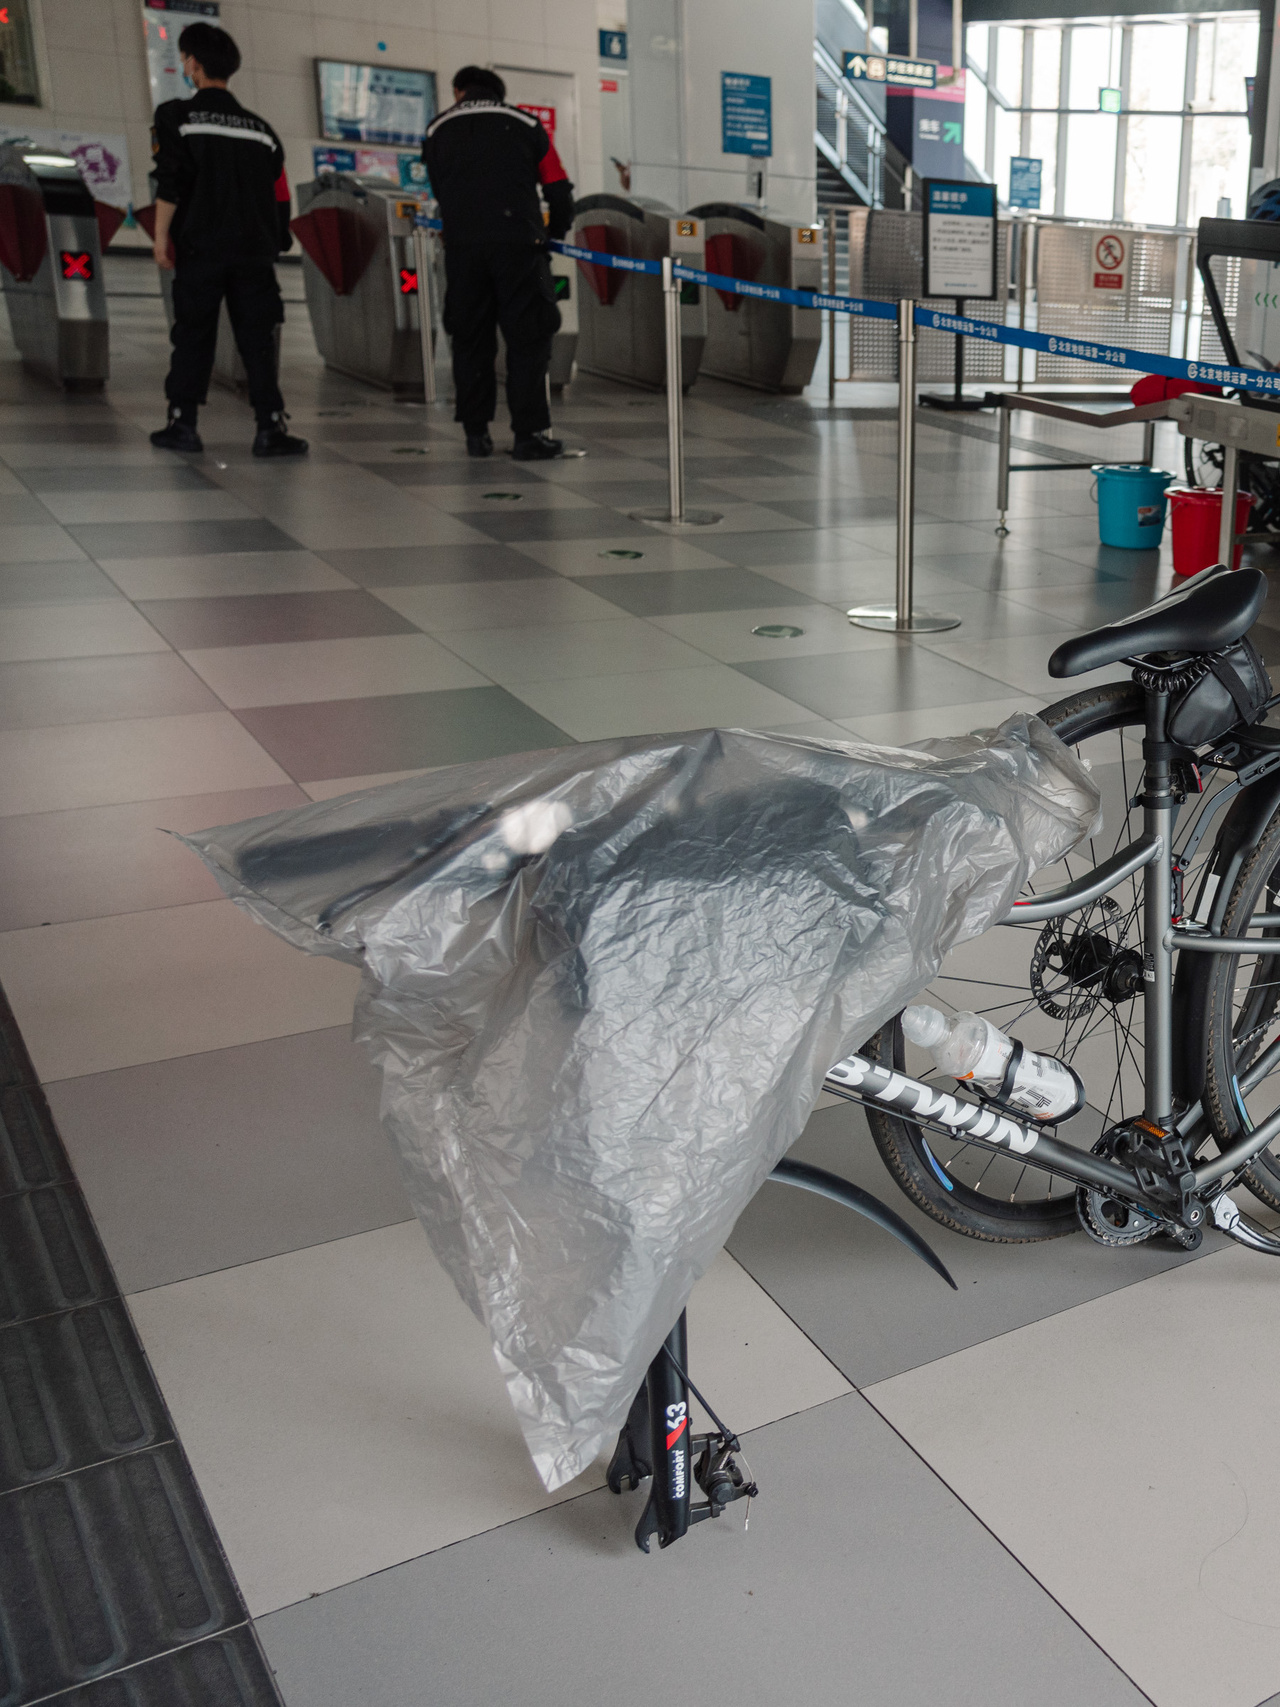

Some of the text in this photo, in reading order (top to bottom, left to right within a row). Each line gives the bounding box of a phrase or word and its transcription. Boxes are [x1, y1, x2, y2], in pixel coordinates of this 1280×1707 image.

[1057, 341, 1127, 365] 北京地铁运营一分公司
[672, 1449, 685, 1499] COMFORT
